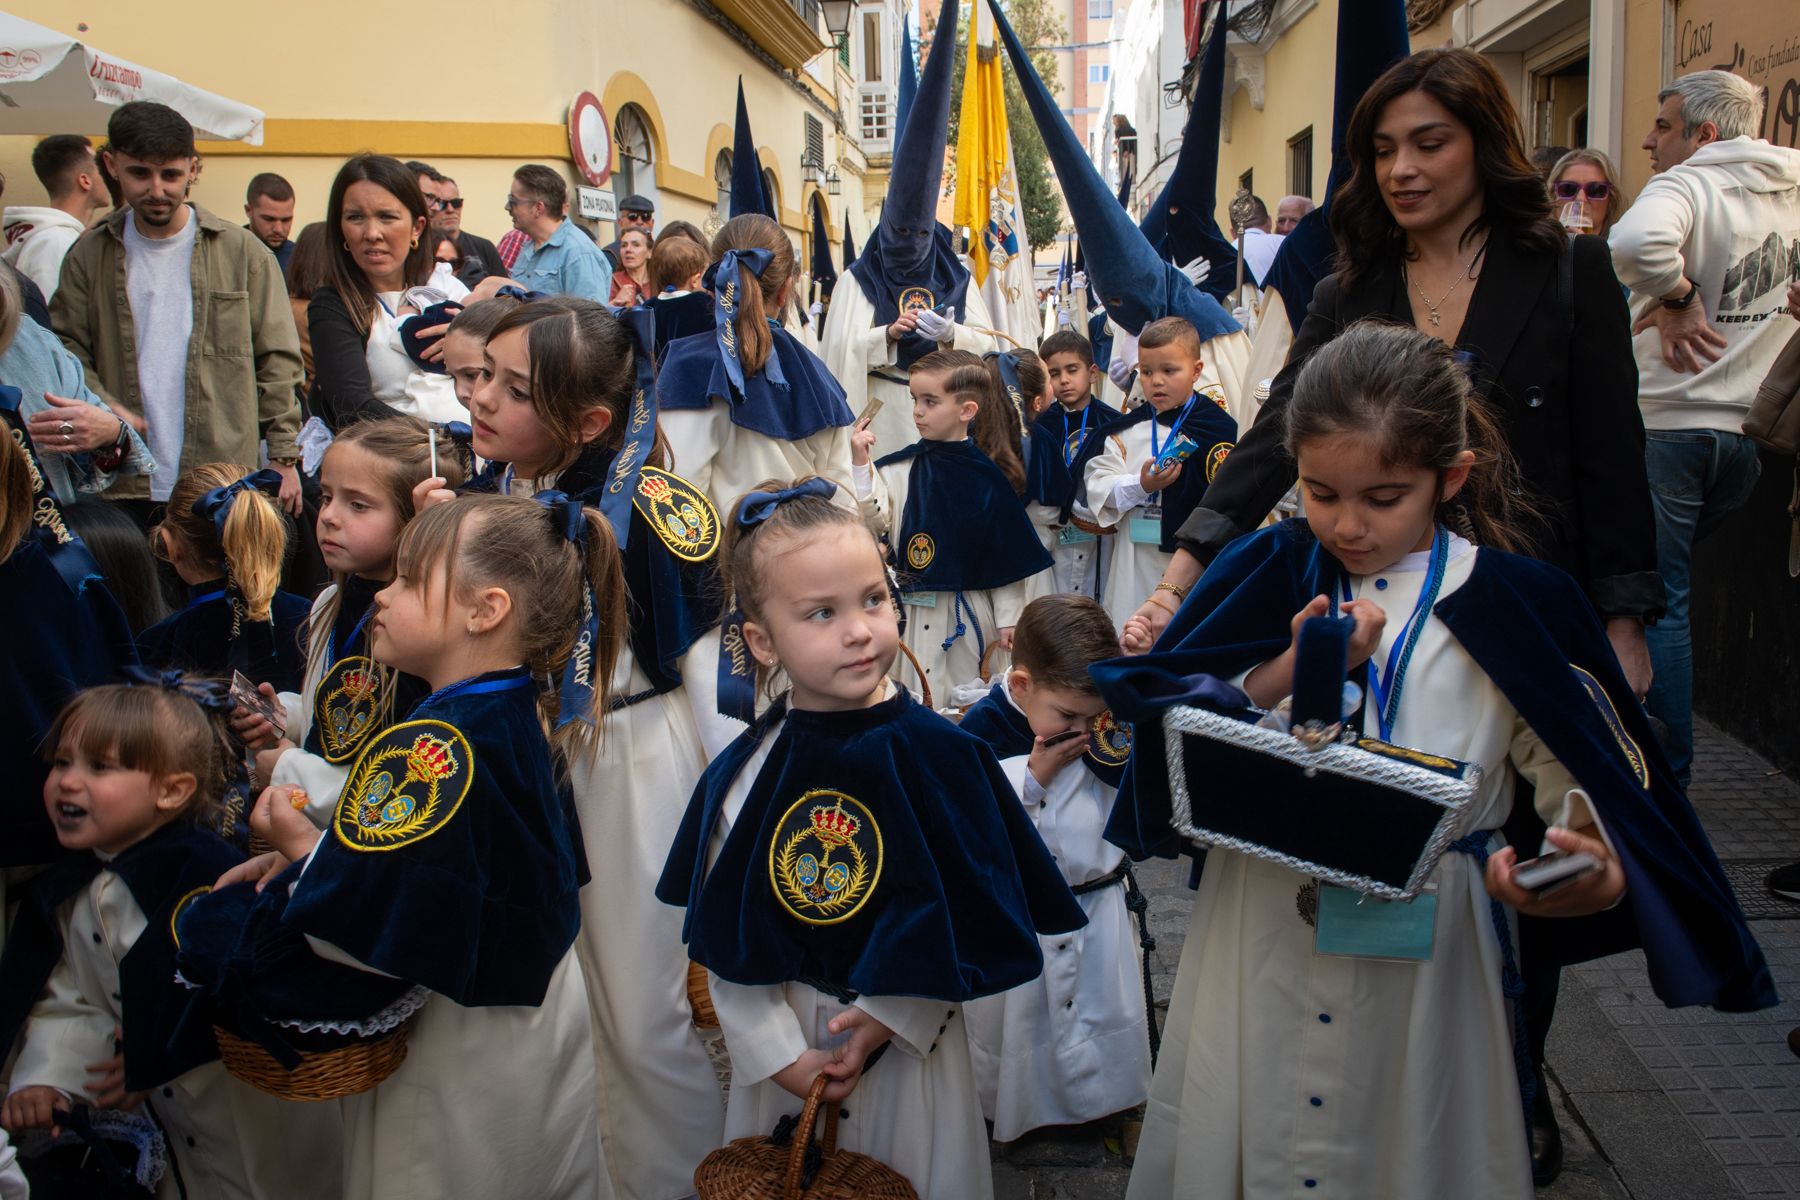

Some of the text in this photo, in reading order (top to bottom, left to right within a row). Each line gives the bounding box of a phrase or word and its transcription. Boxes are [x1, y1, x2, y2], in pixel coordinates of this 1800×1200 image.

[1677, 19, 1713, 68] Casa
[90, 54, 142, 91] Cruzcampo
[1748, 55, 1766, 78] Casa
[1715, 314, 1750, 323] KEEP
